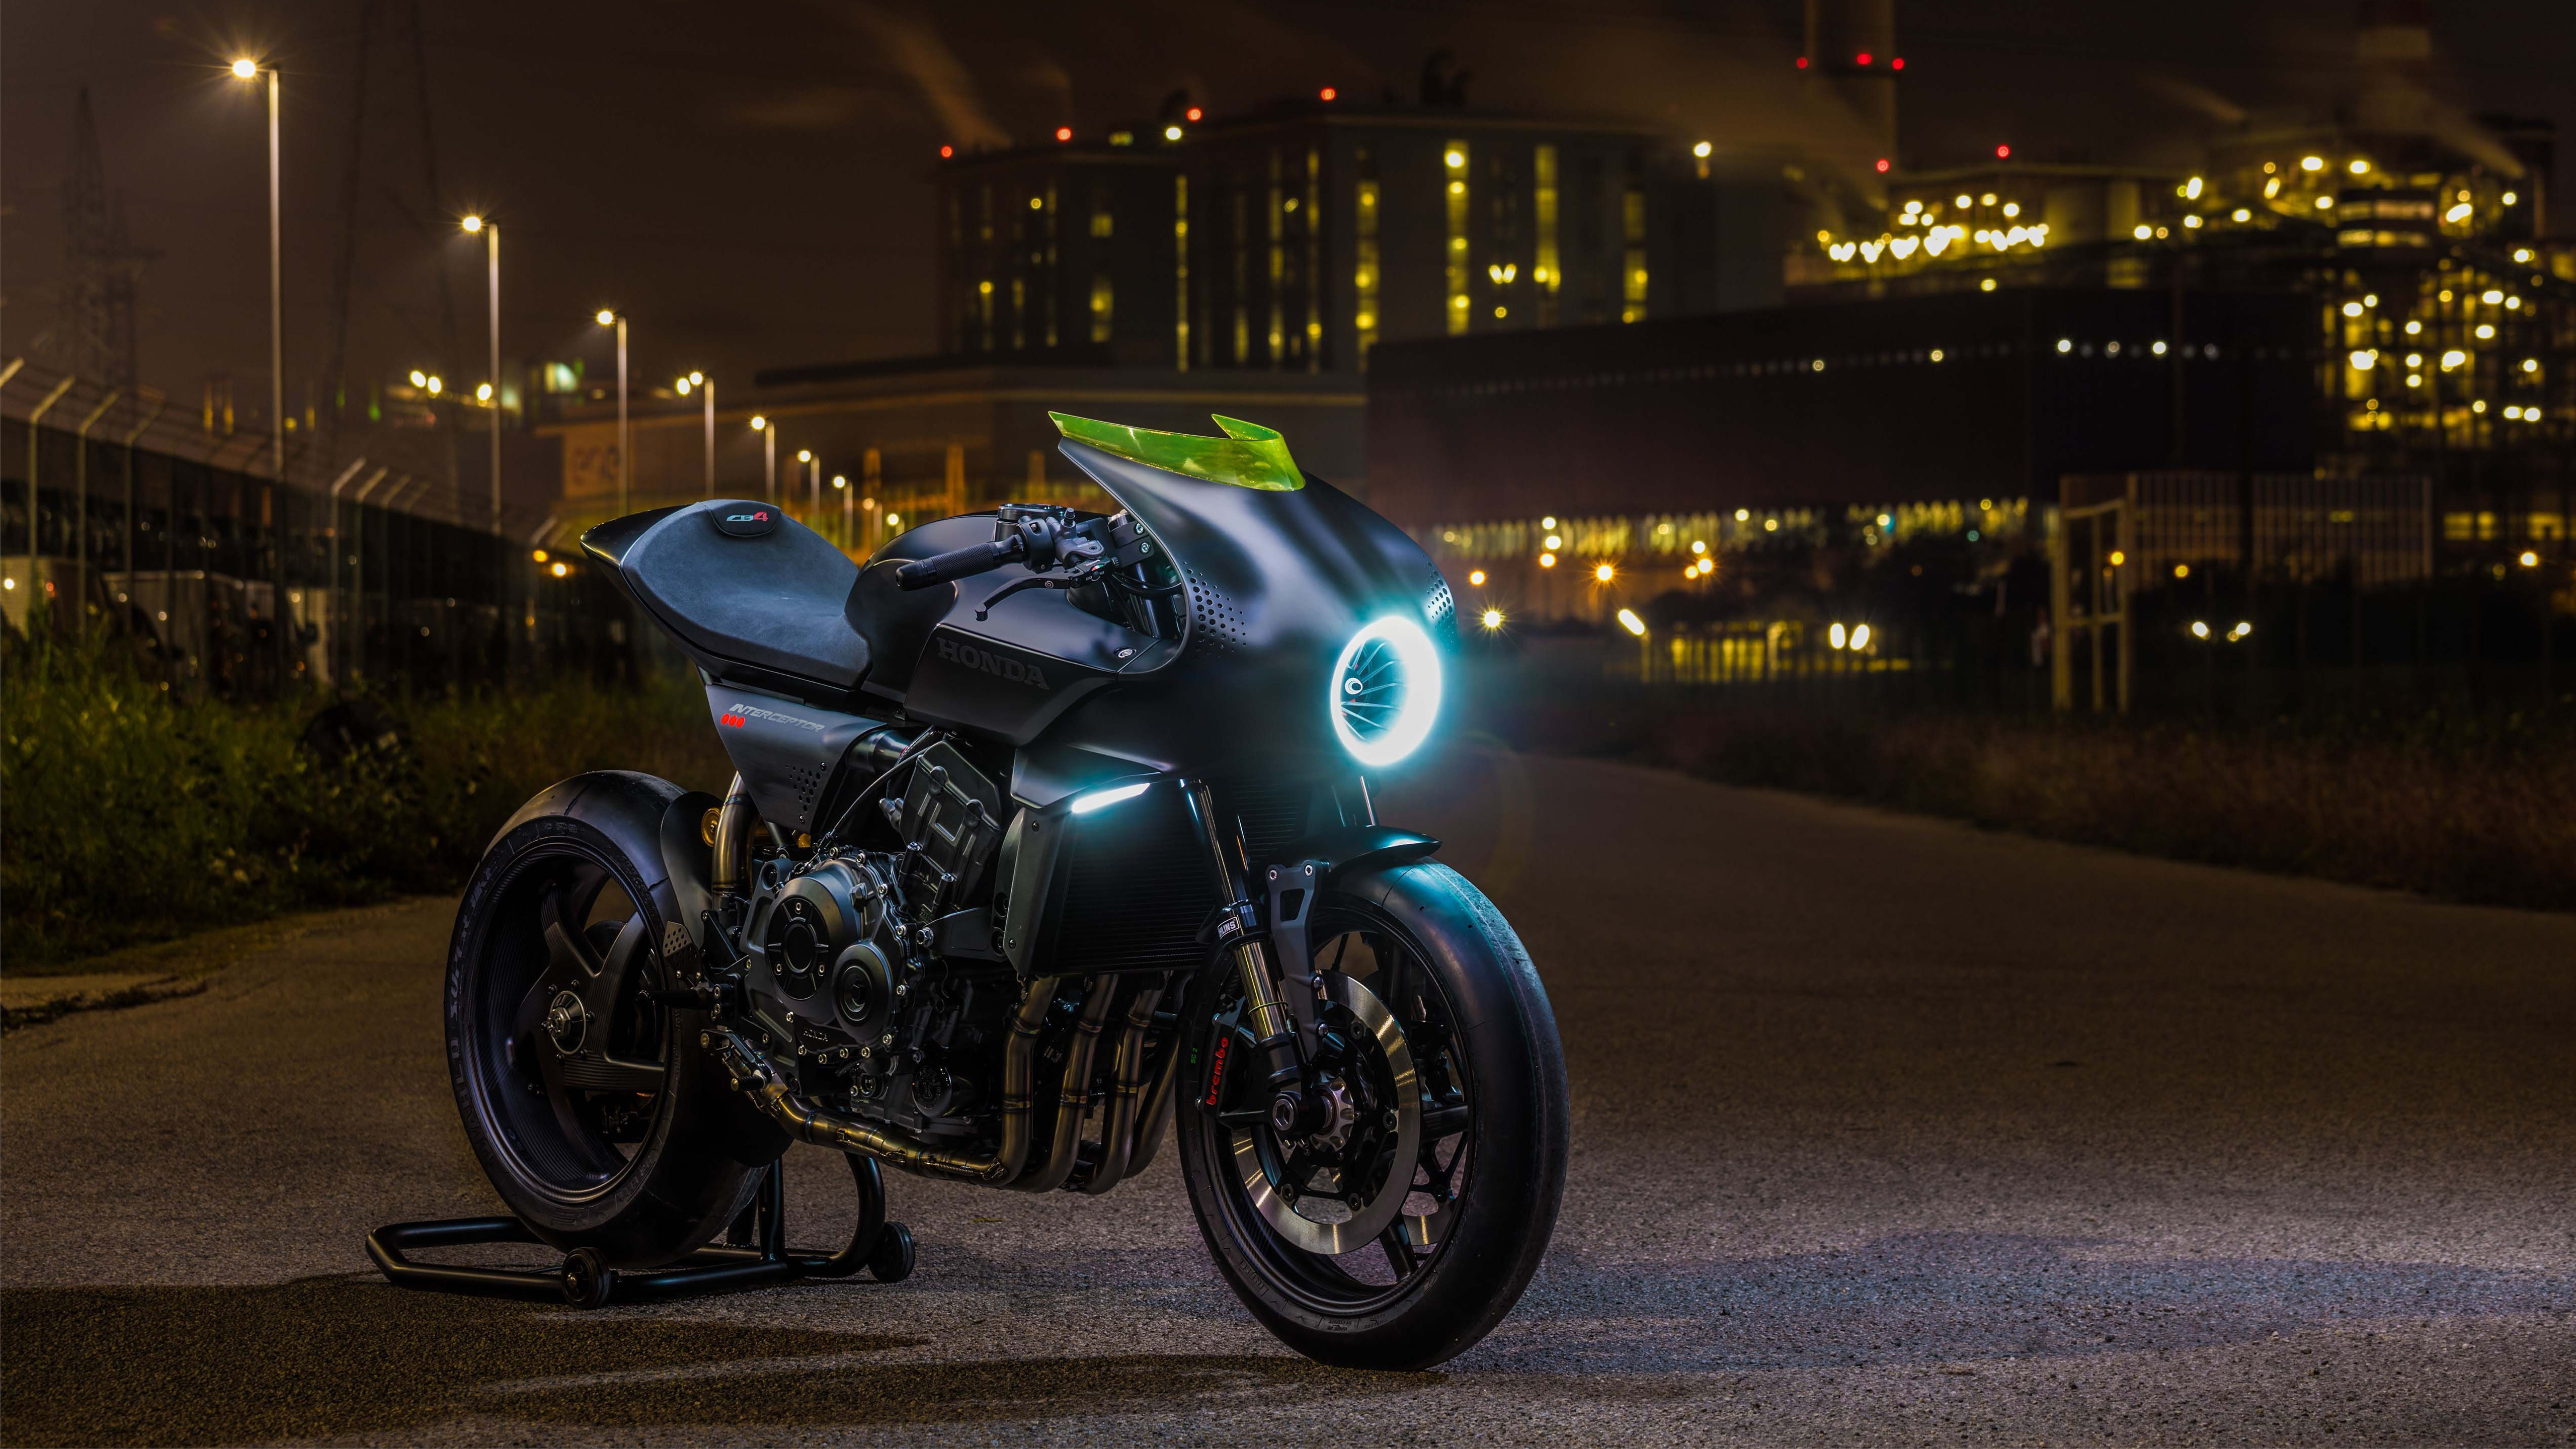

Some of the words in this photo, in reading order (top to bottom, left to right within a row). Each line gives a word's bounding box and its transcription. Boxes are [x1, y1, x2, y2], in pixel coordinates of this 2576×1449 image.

[726, 512, 769, 522] CB4
[936, 637, 1050, 690] HONDA
[729, 703, 826, 733] INTERCEPTOR
[1206, 1037, 1229, 1105] brembo
